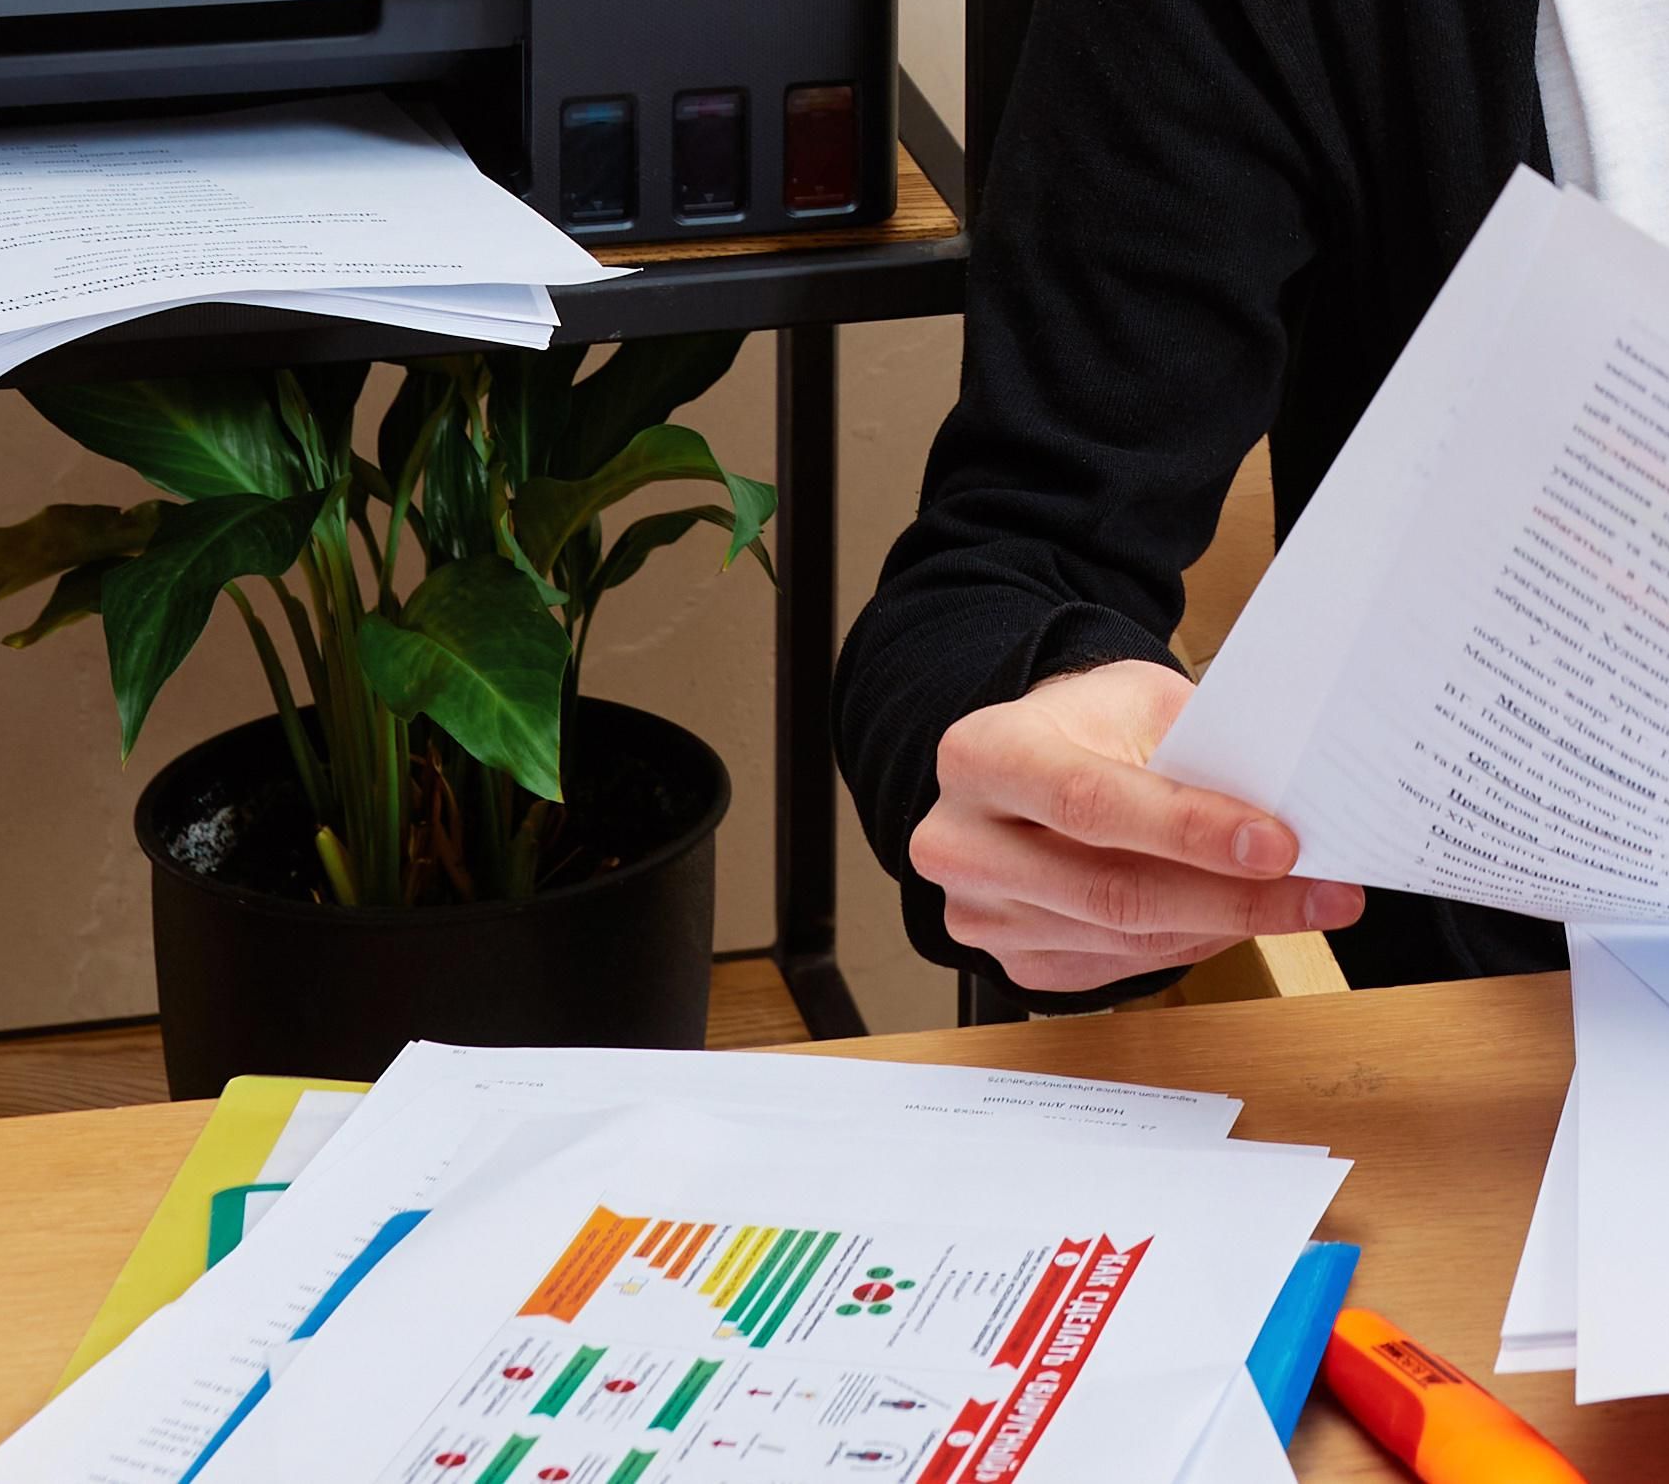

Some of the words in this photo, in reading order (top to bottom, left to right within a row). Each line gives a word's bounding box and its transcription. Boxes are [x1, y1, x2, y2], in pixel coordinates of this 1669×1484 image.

[981, 1092, 1034, 1108] специй
[1037, 1098, 1064, 1111] для
[1066, 1101, 1125, 1117] Наборы
[1086, 1253, 1131, 1292] КАК
[1041, 1290, 1109, 1367] СДЕЛАТЬ
